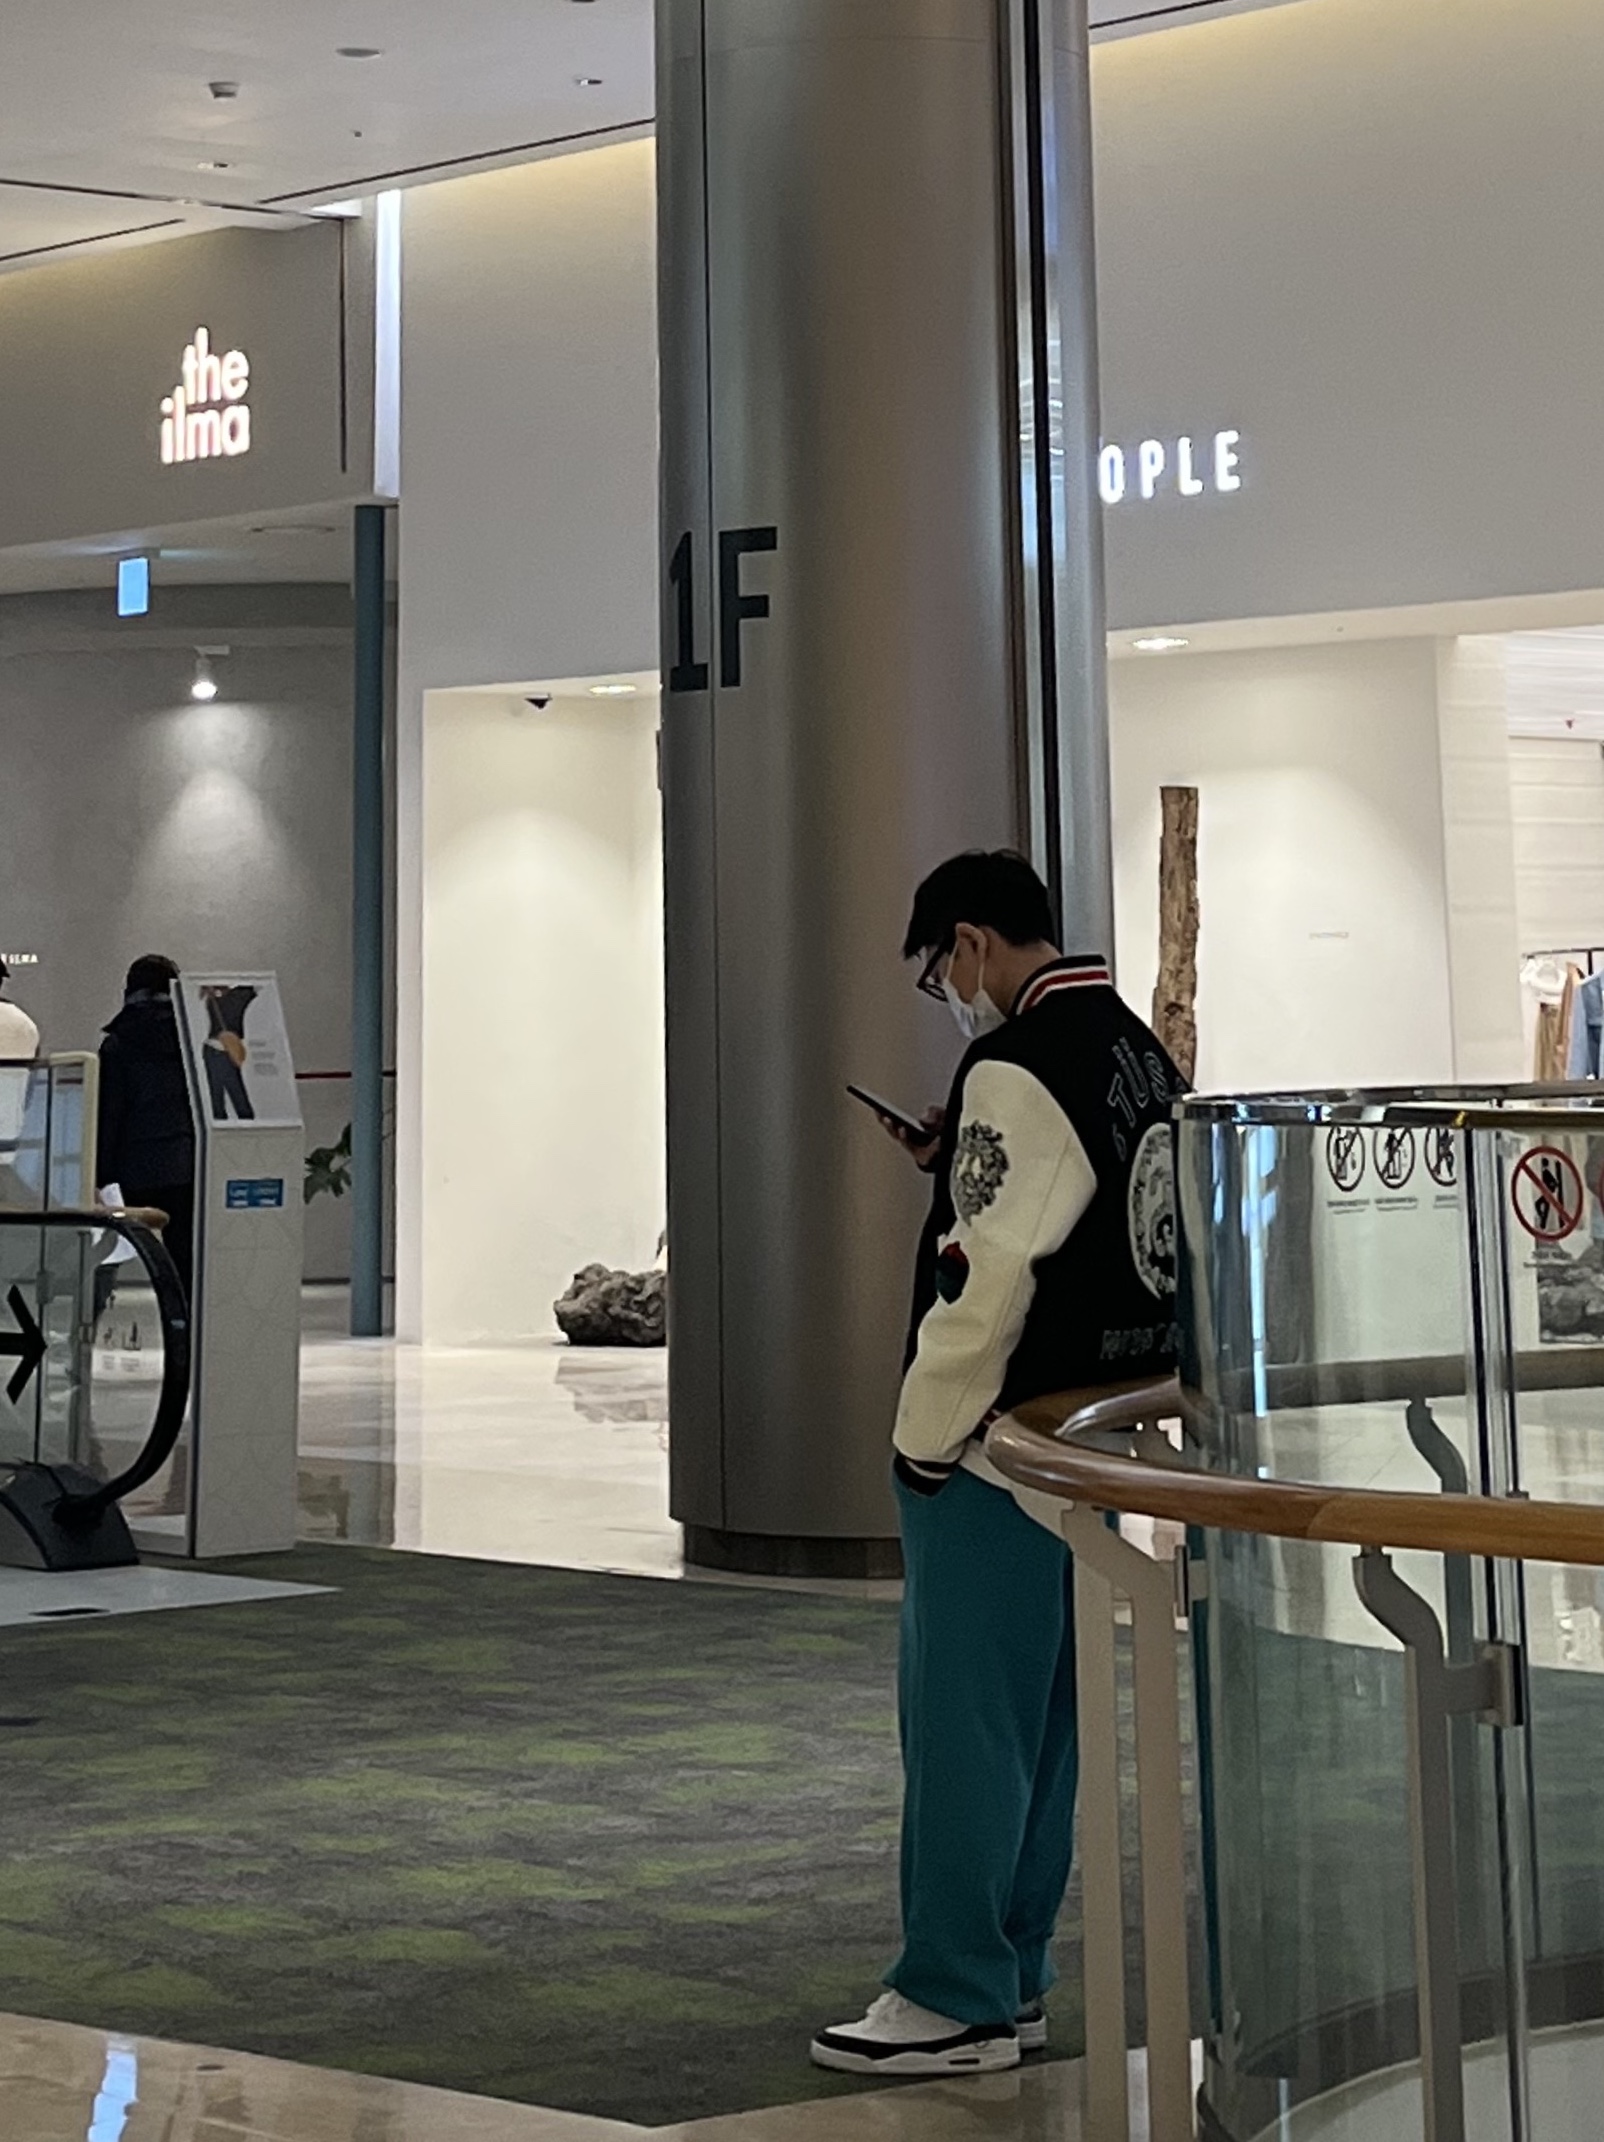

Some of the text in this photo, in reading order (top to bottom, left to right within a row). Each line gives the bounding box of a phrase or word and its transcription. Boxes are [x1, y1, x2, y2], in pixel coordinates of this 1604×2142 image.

[182, 327, 249, 405] the
[161, 384, 250, 464] ilma
[669, 526, 777, 692] 1F
